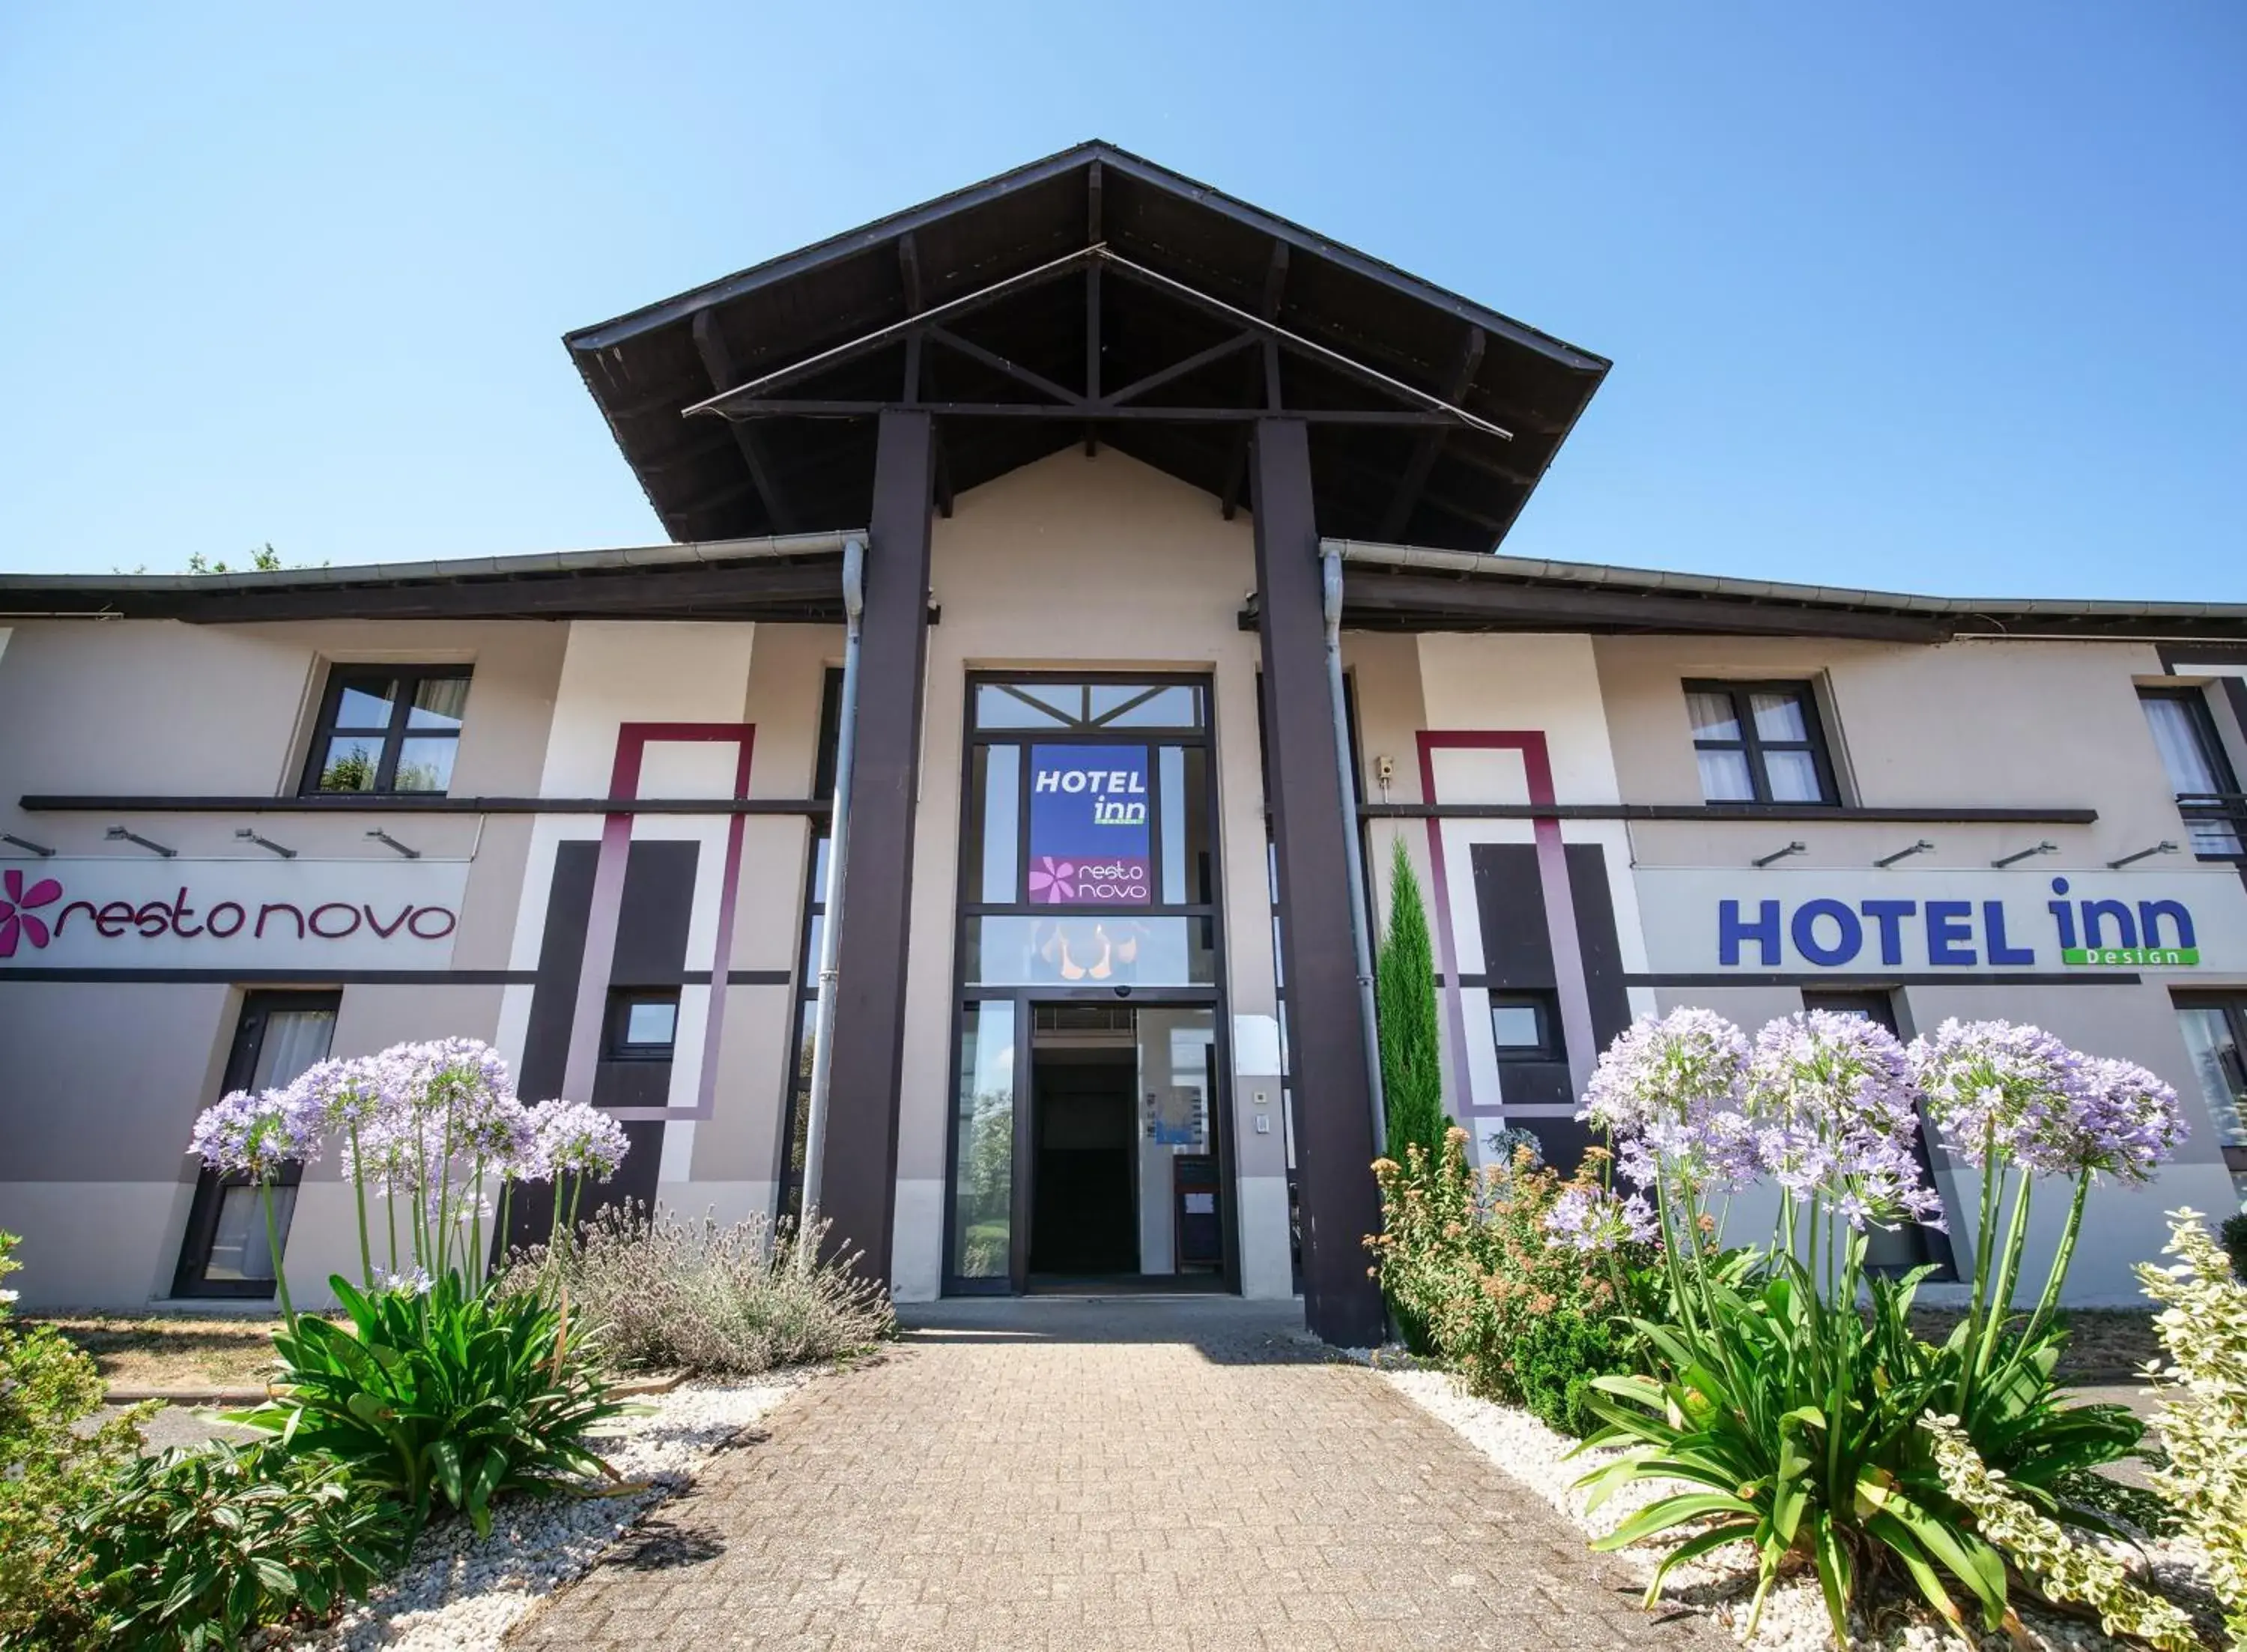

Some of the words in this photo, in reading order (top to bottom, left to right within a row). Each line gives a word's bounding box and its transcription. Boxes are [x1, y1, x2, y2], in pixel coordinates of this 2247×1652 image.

[1035, 770, 1145, 793] HOTEL
[1094, 795, 1145, 821] inn
[1079, 860, 1143, 880] resto
[1079, 884, 1147, 899] novo
[54, 886, 246, 938] resto
[254, 902, 456, 940] novo
[1718, 899, 2035, 967] HOTEL
[2048, 876, 2197, 950] inn
